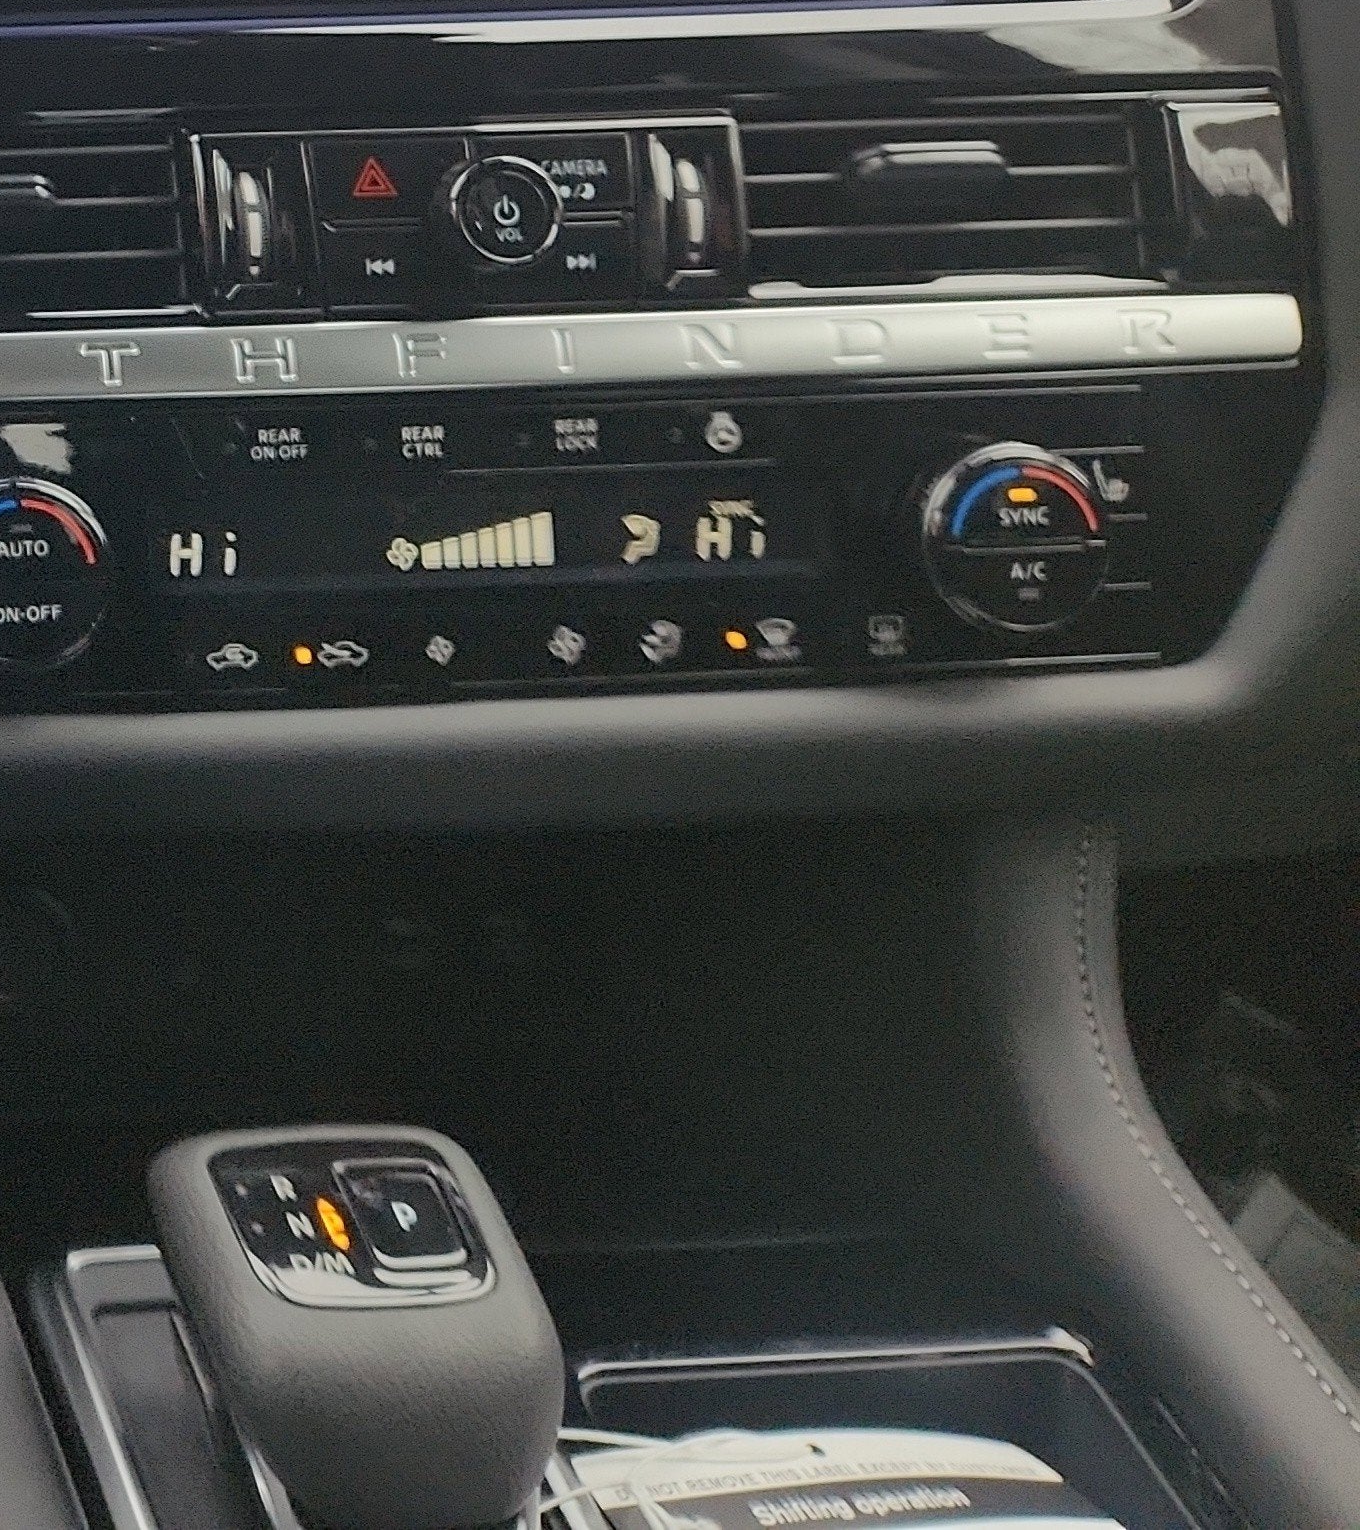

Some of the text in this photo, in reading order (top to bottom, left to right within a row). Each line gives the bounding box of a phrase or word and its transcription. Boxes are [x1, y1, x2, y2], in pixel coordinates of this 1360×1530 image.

[541, 159, 608, 177] CAMERA
[495, 227, 524, 243] VOL
[258, 428, 301, 443] REAR
[401, 425, 445, 442] REAR
[554, 418, 599, 434] REAR
[402, 443, 445, 459] CTRL
[555, 435, 598, 451] LOCK
[999, 506, 1049, 527] SYNC
[169, 532, 237, 577] Hi
[1010, 561, 1048, 581] A/C
[269, 1174, 298, 1203] R
[285, 1211, 315, 1241] N
[391, 1201, 418, 1233] P
[749, 1484, 972, 1527] Shifting operation
